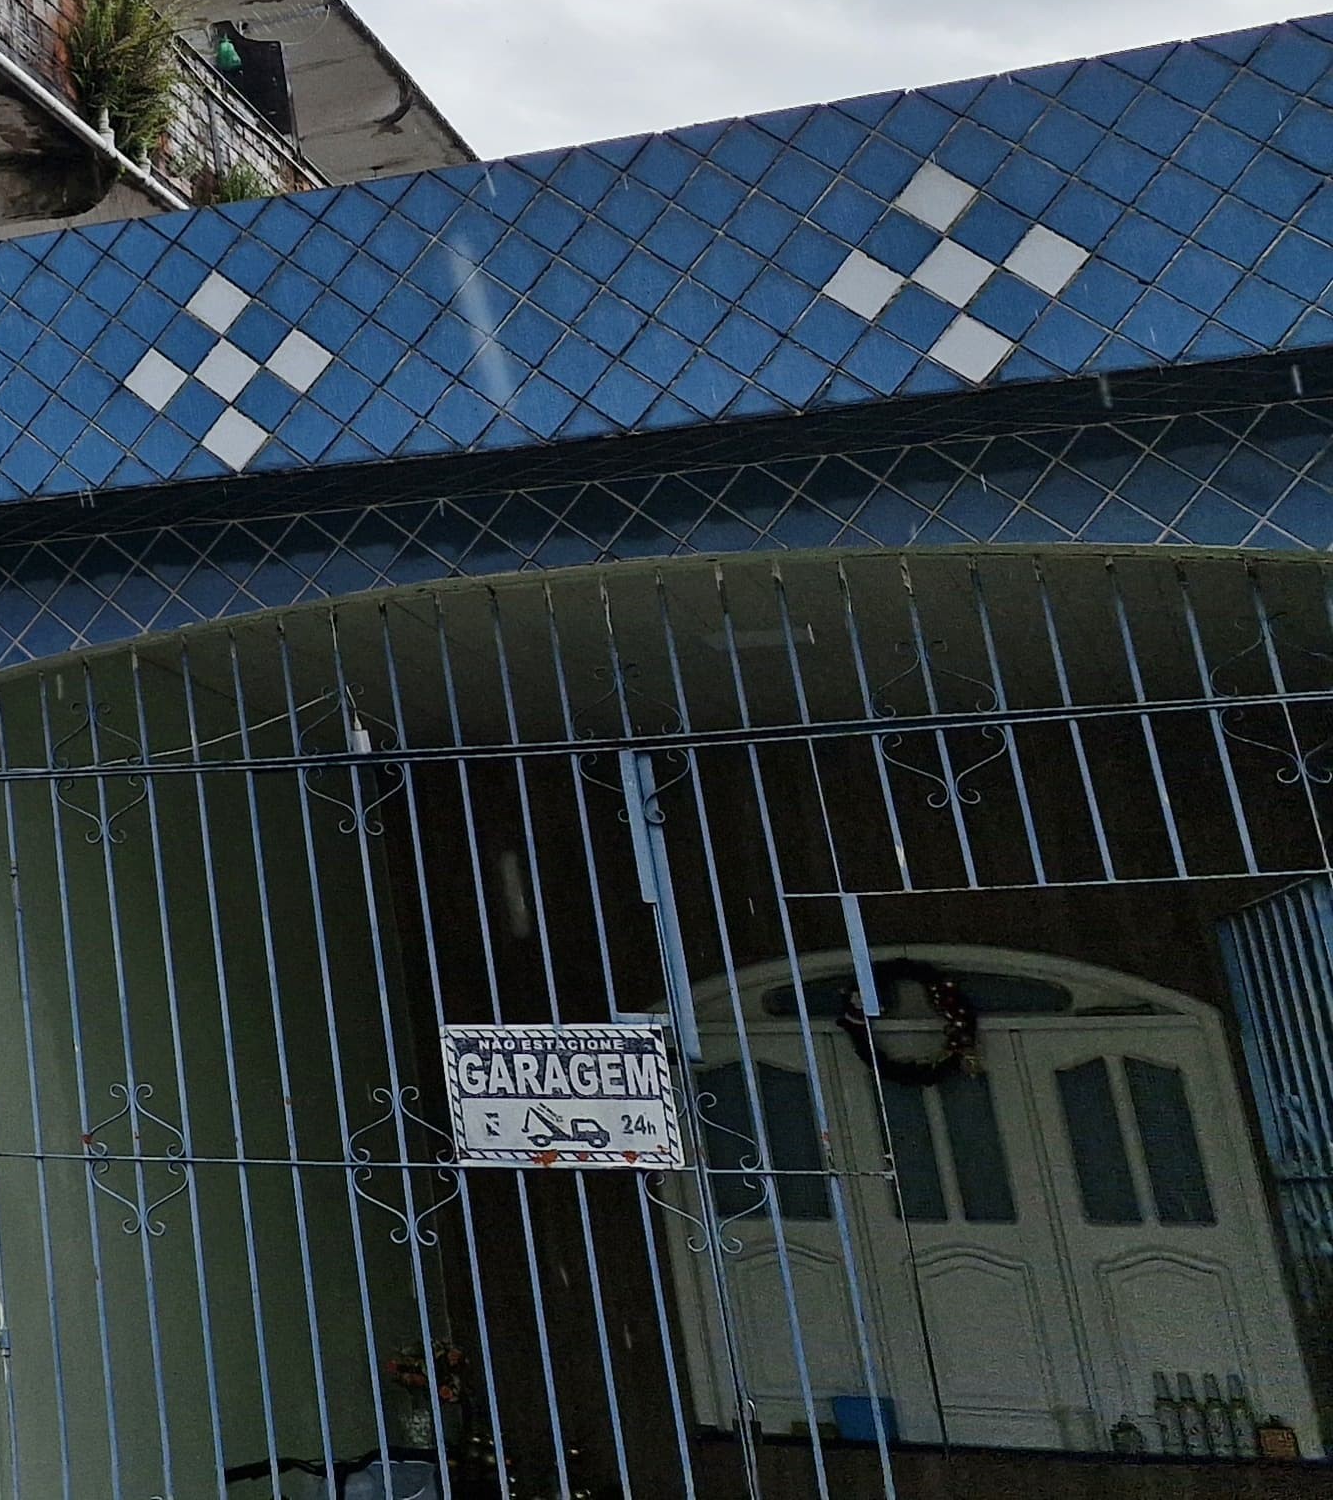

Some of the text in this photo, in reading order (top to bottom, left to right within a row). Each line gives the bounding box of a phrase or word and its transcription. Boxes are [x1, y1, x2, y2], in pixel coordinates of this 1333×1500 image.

[521, 1039, 625, 1051] ESTACIONE
[457, 1053, 660, 1096] GARAGEM
[621, 1114, 657, 1135] 24h
